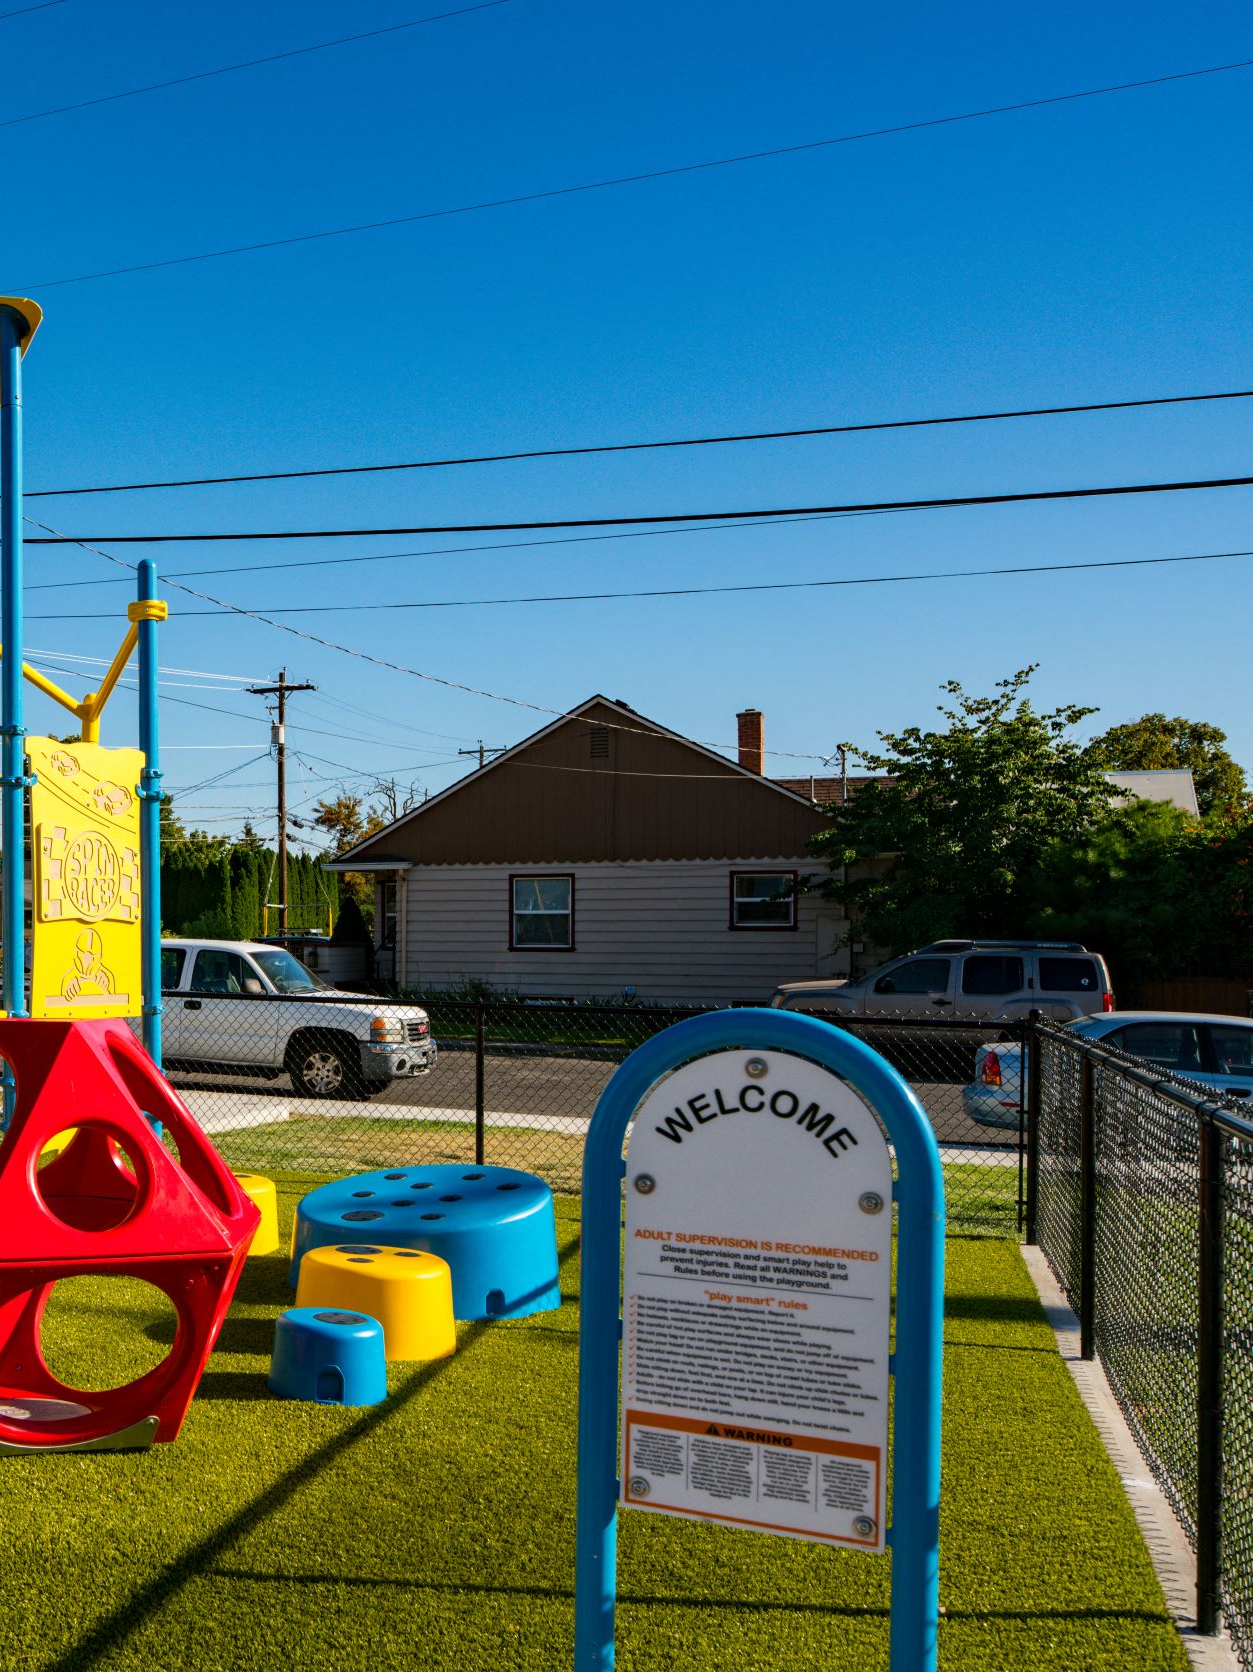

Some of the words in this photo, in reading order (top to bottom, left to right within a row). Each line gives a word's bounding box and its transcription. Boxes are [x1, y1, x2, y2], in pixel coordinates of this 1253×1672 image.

[70, 838, 114, 876] SPIN
[71, 878, 115, 912] RACER
[655, 1085, 858, 1158] WELCOME
[635, 1228, 673, 1241] ADULT
[675, 1232, 757, 1250] SUPERVISION
[762, 1241, 772, 1251] IS
[776, 1242, 879, 1262] RECOMMENDED
[662, 1244, 687, 1254] Close
[690, 1247, 741, 1260] supervision
[744, 1253, 760, 1261] and
[763, 1255, 790, 1264] smart
[792, 1258, 812, 1268] play
[814, 1260, 834, 1270] help
[660, 1254, 694, 1265] prevent
[696, 1258, 731, 1269] injuries.
[734, 1262, 757, 1271] Read
[760, 1264, 770, 1272] all
[773, 1266, 828, 1279] WARNINGS
[830, 1272, 848, 1281] and
[674, 1265, 698, 1275] Rules
[702, 1268, 730, 1278] before
[733, 1272, 757, 1283] using
[760, 1275, 774, 1283] the
[777, 1276, 833, 1291] playground.
[778, 1298, 809, 1311] rules
[724, 1427, 794, 1447] WARNING
